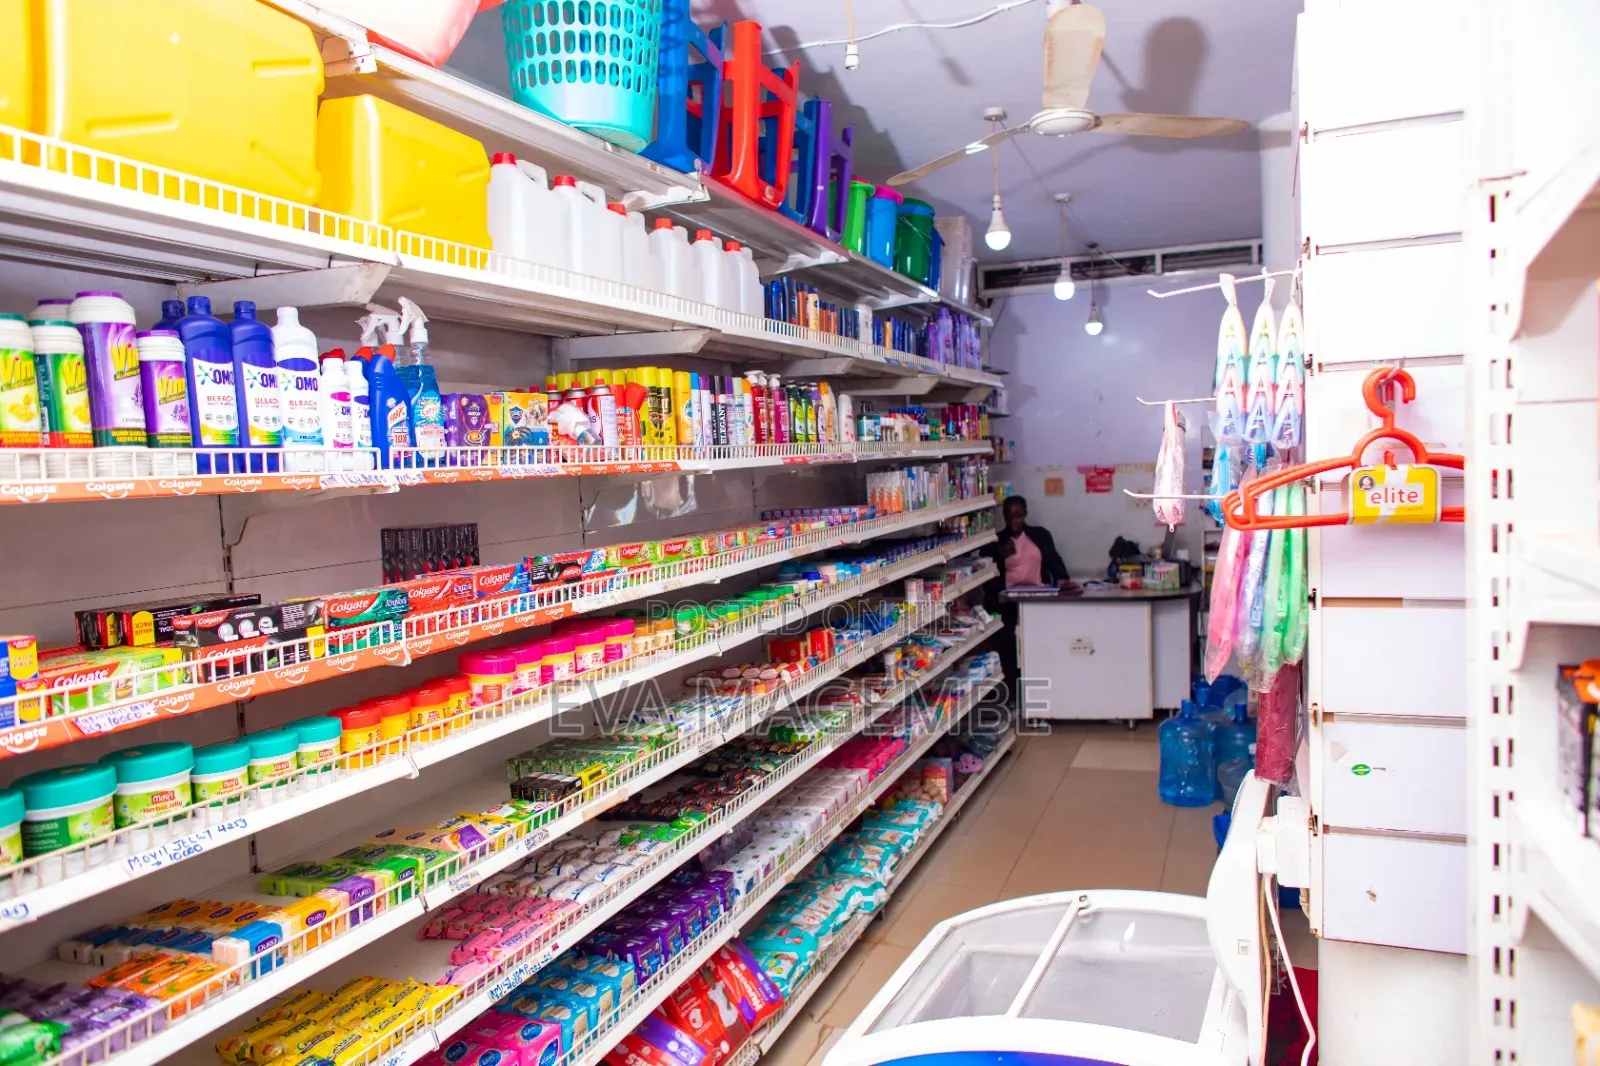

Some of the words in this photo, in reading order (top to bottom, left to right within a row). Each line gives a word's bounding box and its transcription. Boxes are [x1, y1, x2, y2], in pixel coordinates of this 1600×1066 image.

[295, 376, 319, 392] OMO
[281, 476, 316, 485] Colgate
[433, 471, 460, 479] Colgate
[85, 482, 135, 494] Colgate
[159, 479, 203, 490] Colgate
[223, 477, 263, 487] Colgate
[0, 484, 57, 496] Colgate
[1370, 487, 1419, 504] elite
[479, 571, 511, 586] Colgate
[408, 585, 440, 598] Colgate
[330, 600, 369, 613] Colgate
[198, 614, 224, 625] Colgate
[514, 613, 536, 624] Colgate
[481, 620, 505, 632] Colgate
[446, 629, 471, 640] Colgate
[373, 643, 403, 657] Colgate
[407, 638, 434, 651] Colgate
[327, 653, 360, 668] Colgate
[53, 669, 109, 690] Colgate
[274, 665, 310, 681] Colgate
[217, 677, 256, 694] Colgate
[152, 691, 195, 709] Colgate
[0, 725, 48, 746] olgate
[308, 911, 326, 923] DURU
[257, 936, 278, 953] DURU
